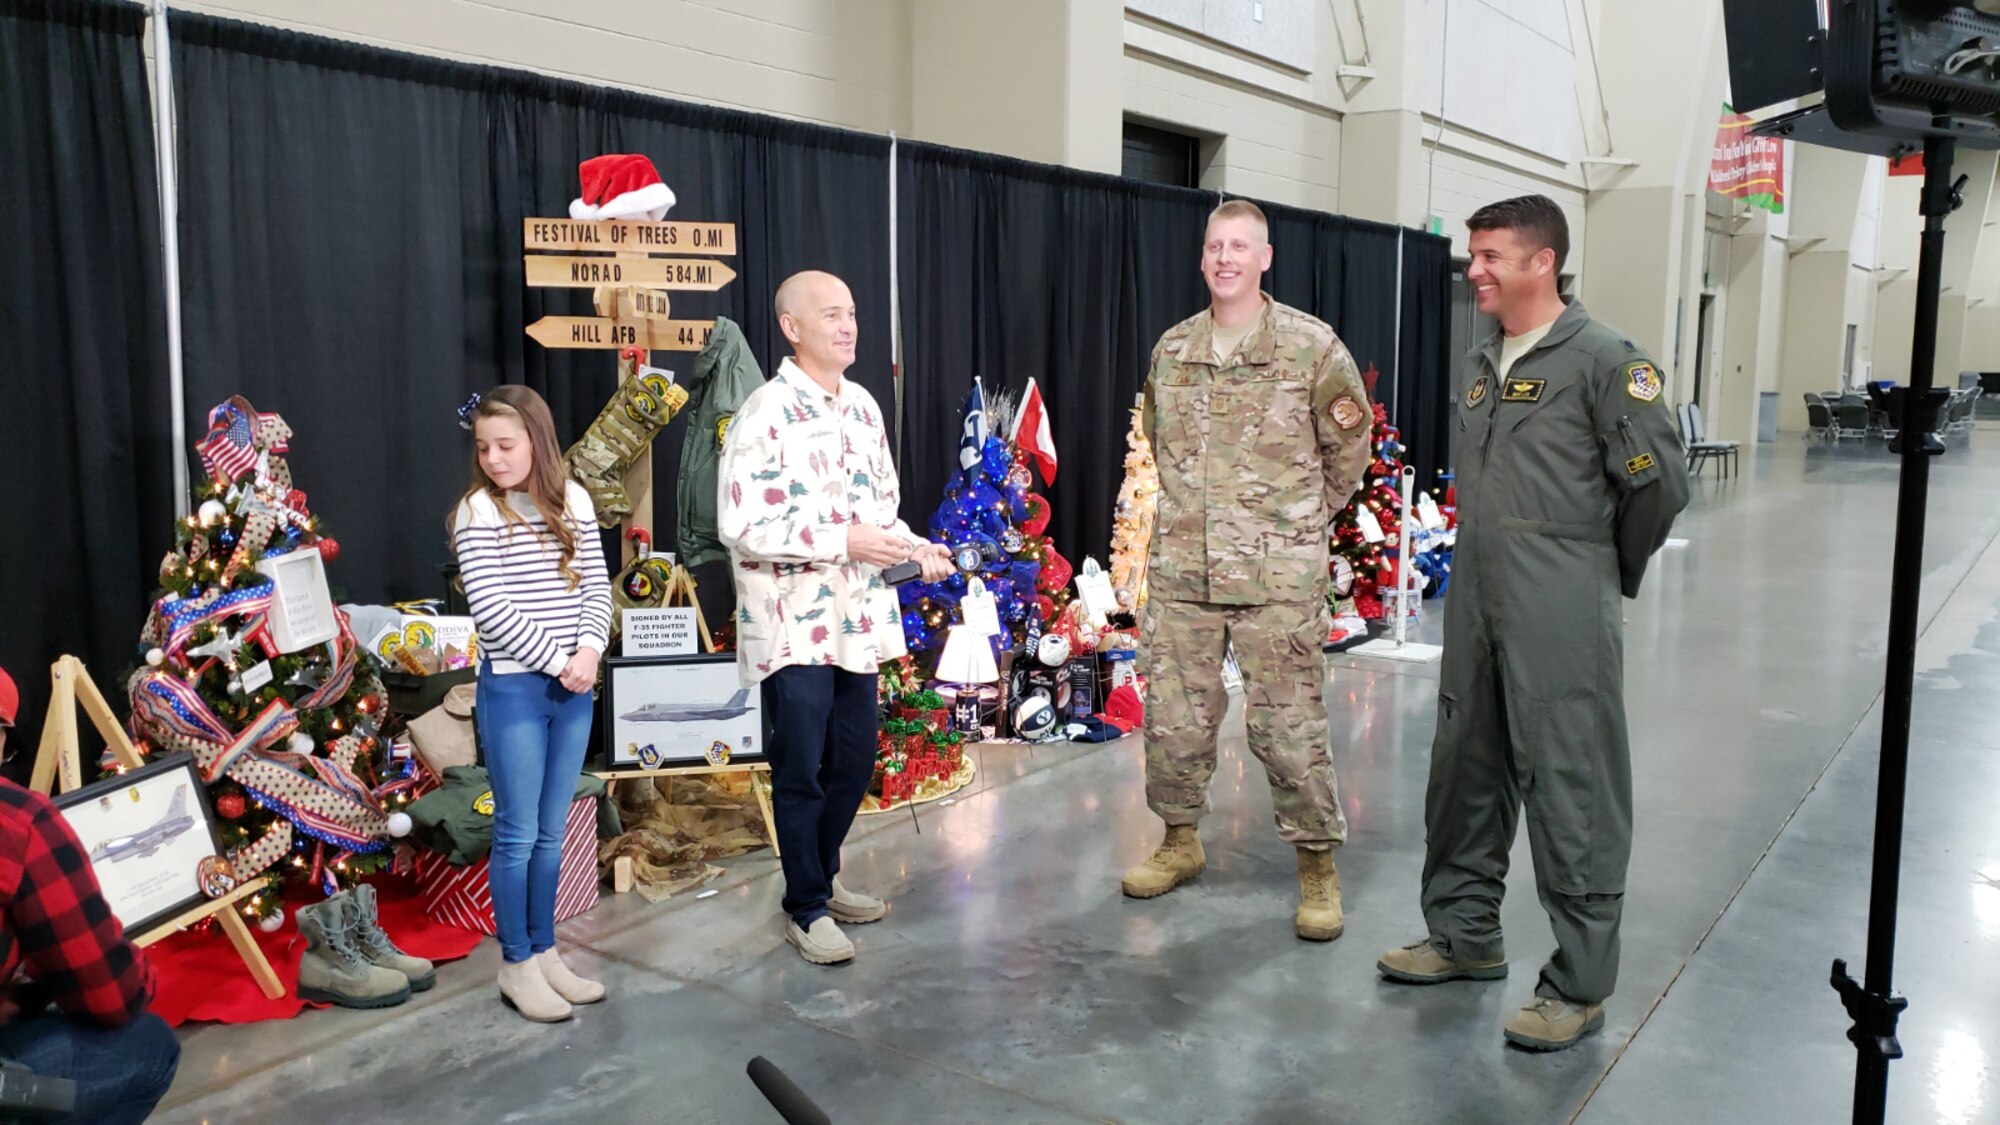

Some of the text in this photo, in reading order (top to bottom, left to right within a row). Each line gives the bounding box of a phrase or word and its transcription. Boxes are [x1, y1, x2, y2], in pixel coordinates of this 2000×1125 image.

[534, 224, 600, 242] FESTIVAL
[611, 225, 628, 243] OF
[637, 226, 677, 245] TREES
[572, 263, 621, 282] NORAD
[572, 324, 602, 343] HILL
[611, 325, 636, 344] AFB
[638, 641, 682, 649] SQUADRON
